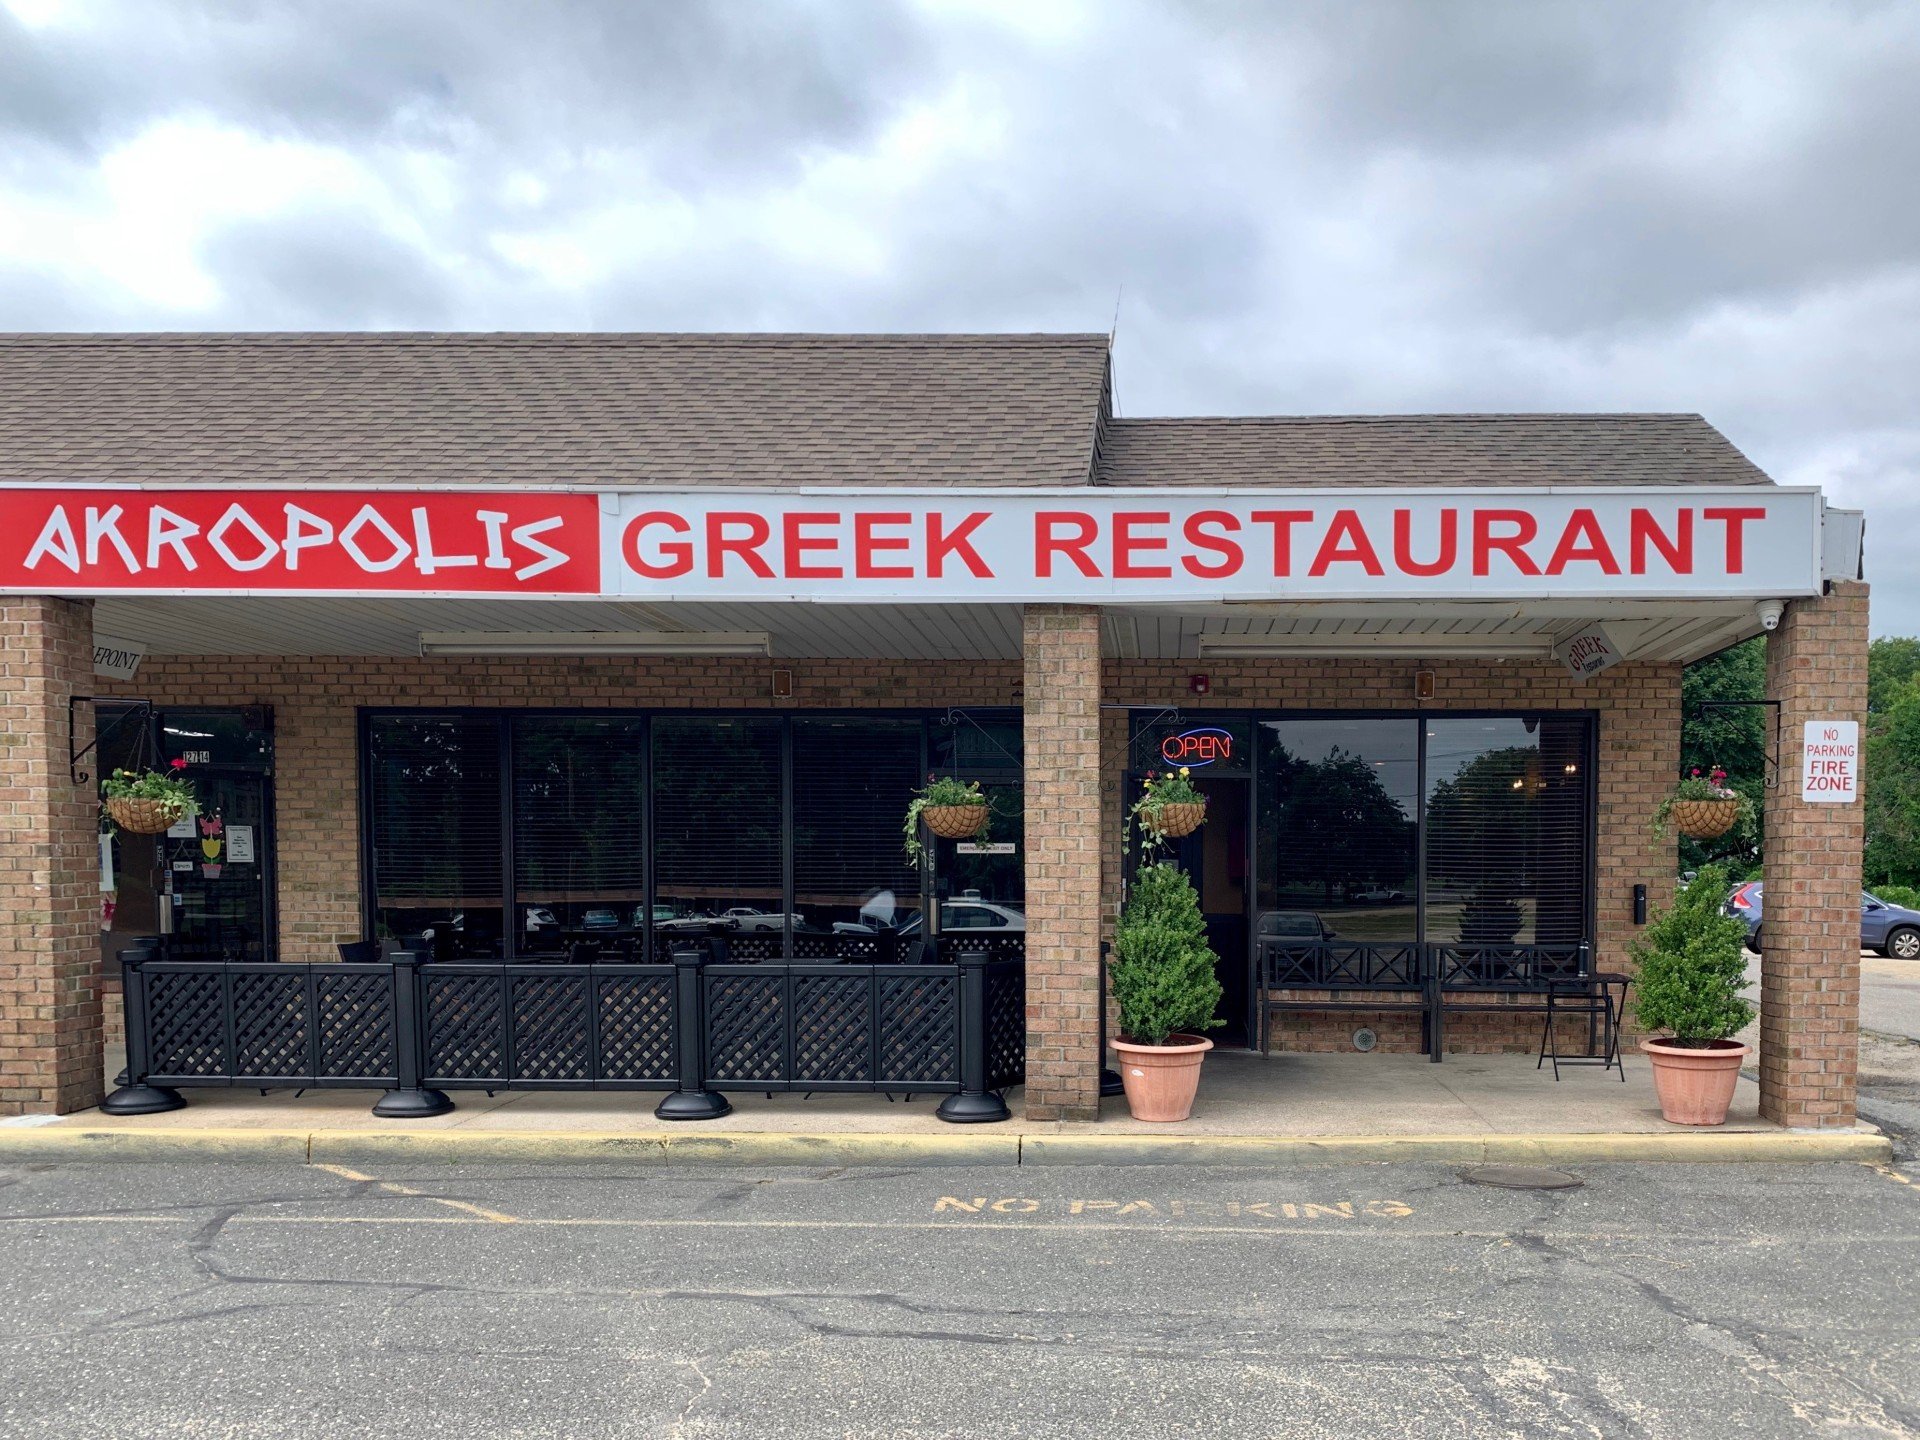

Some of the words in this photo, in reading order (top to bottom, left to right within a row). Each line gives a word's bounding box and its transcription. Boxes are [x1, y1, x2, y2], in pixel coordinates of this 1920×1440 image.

[23, 502, 570, 581] AKROPOLIS
[621, 510, 995, 579] GREEK
[1034, 507, 1767, 579] RESTAURANT
[93, 645, 141, 669] EPOINT
[1568, 636, 1610, 672] GREEK
[1823, 729, 1839, 741] NO
[1162, 736, 1230, 759] OPEN
[1806, 744, 1855, 757] PARKING
[1810, 760, 1849, 775] FIRE
[1806, 776, 1853, 791] ZONE
[933, 1196, 1038, 1213] NO
